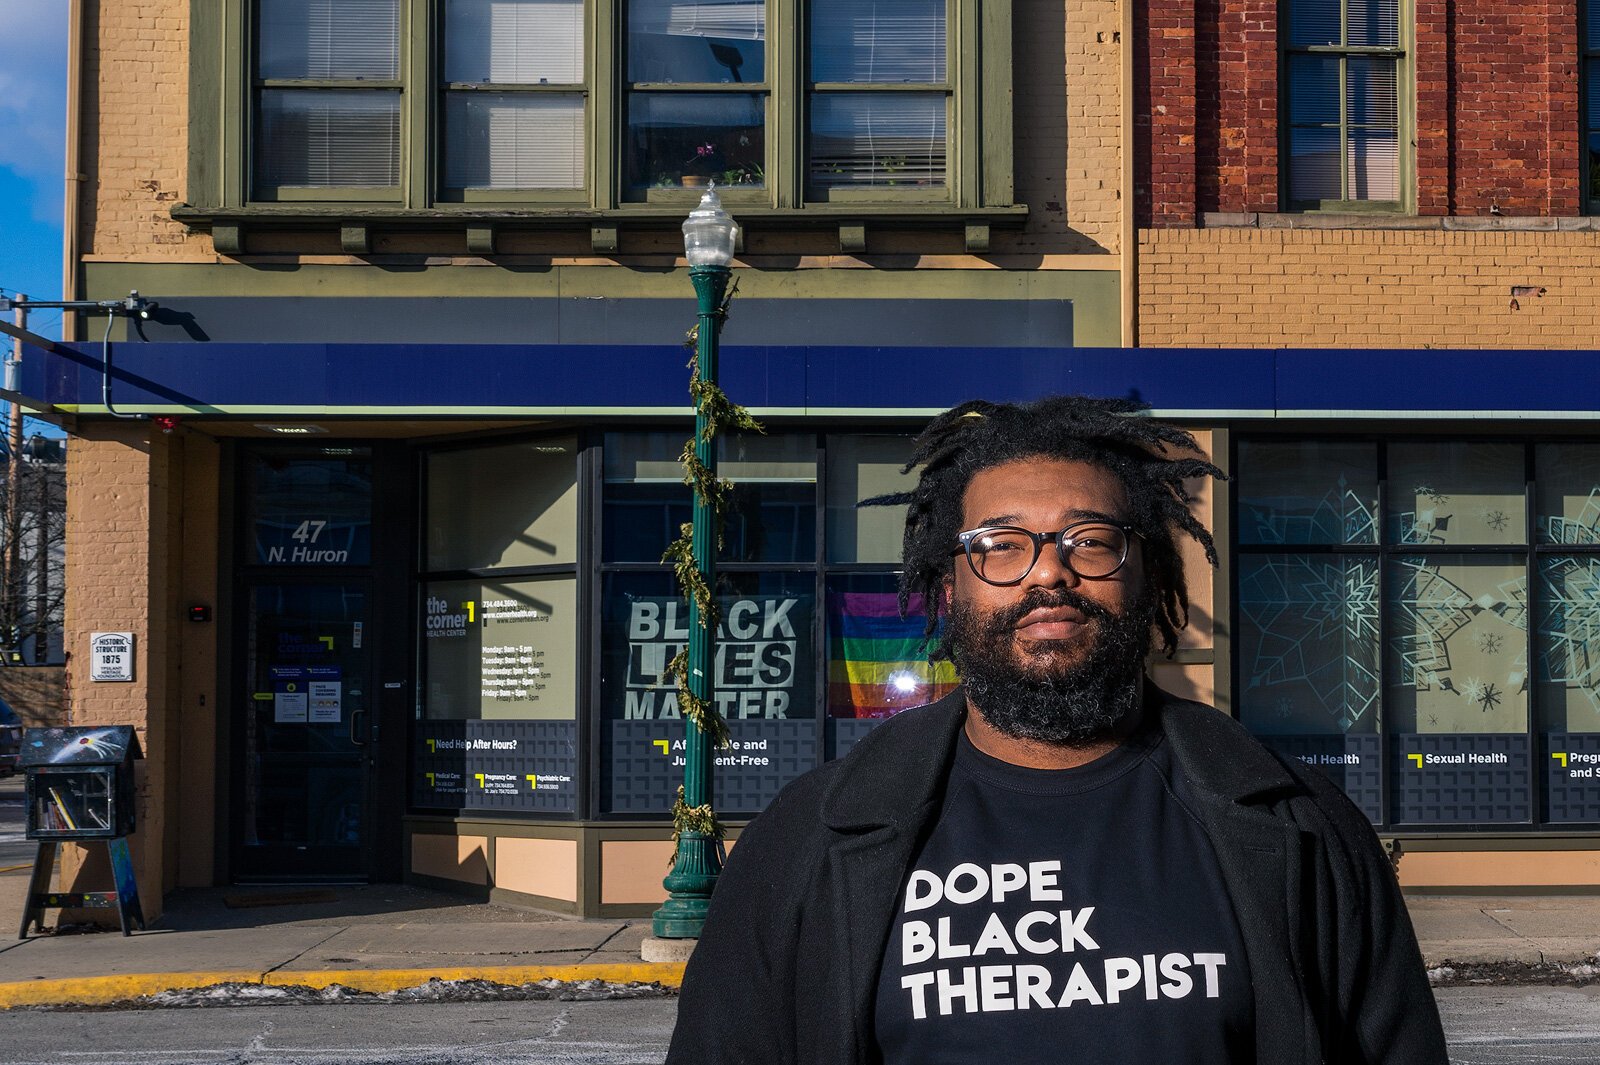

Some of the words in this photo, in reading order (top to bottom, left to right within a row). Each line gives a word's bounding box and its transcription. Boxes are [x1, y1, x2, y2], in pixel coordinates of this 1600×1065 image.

[291, 520, 327, 543] 47
[268, 546, 286, 562] N.
[291, 546, 348, 563] Huron
[427, 596, 447, 614] the
[482, 610, 537, 618] www.cornerhealth.org
[629, 599, 798, 640] BLCK
[426, 614, 467, 628] corner
[446, 629, 466, 637] CENTER
[482, 646, 503, 654] Monday:
[102, 655, 121, 664] 1875
[482, 657, 504, 665] Tuesday:
[482, 667, 513, 675] Wednesday:
[482, 689, 499, 698] Friday:
[624, 691, 791, 720] MATER
[436, 739, 454, 749] Need
[472, 739, 490, 749] After
[492, 739, 517, 750] Hours?
[743, 739, 767, 750] and
[672, 755, 769, 766] Juent-Free
[1321, 754, 1360, 765] Health
[1425, 753, 1465, 764] Sexual
[1469, 753, 1508, 764] Health
[1570, 767, 1593, 778] and
[904, 860, 1063, 913] DOPE
[902, 906, 1100, 966] BLACK
[901, 953, 1227, 1020] THERAPIST
